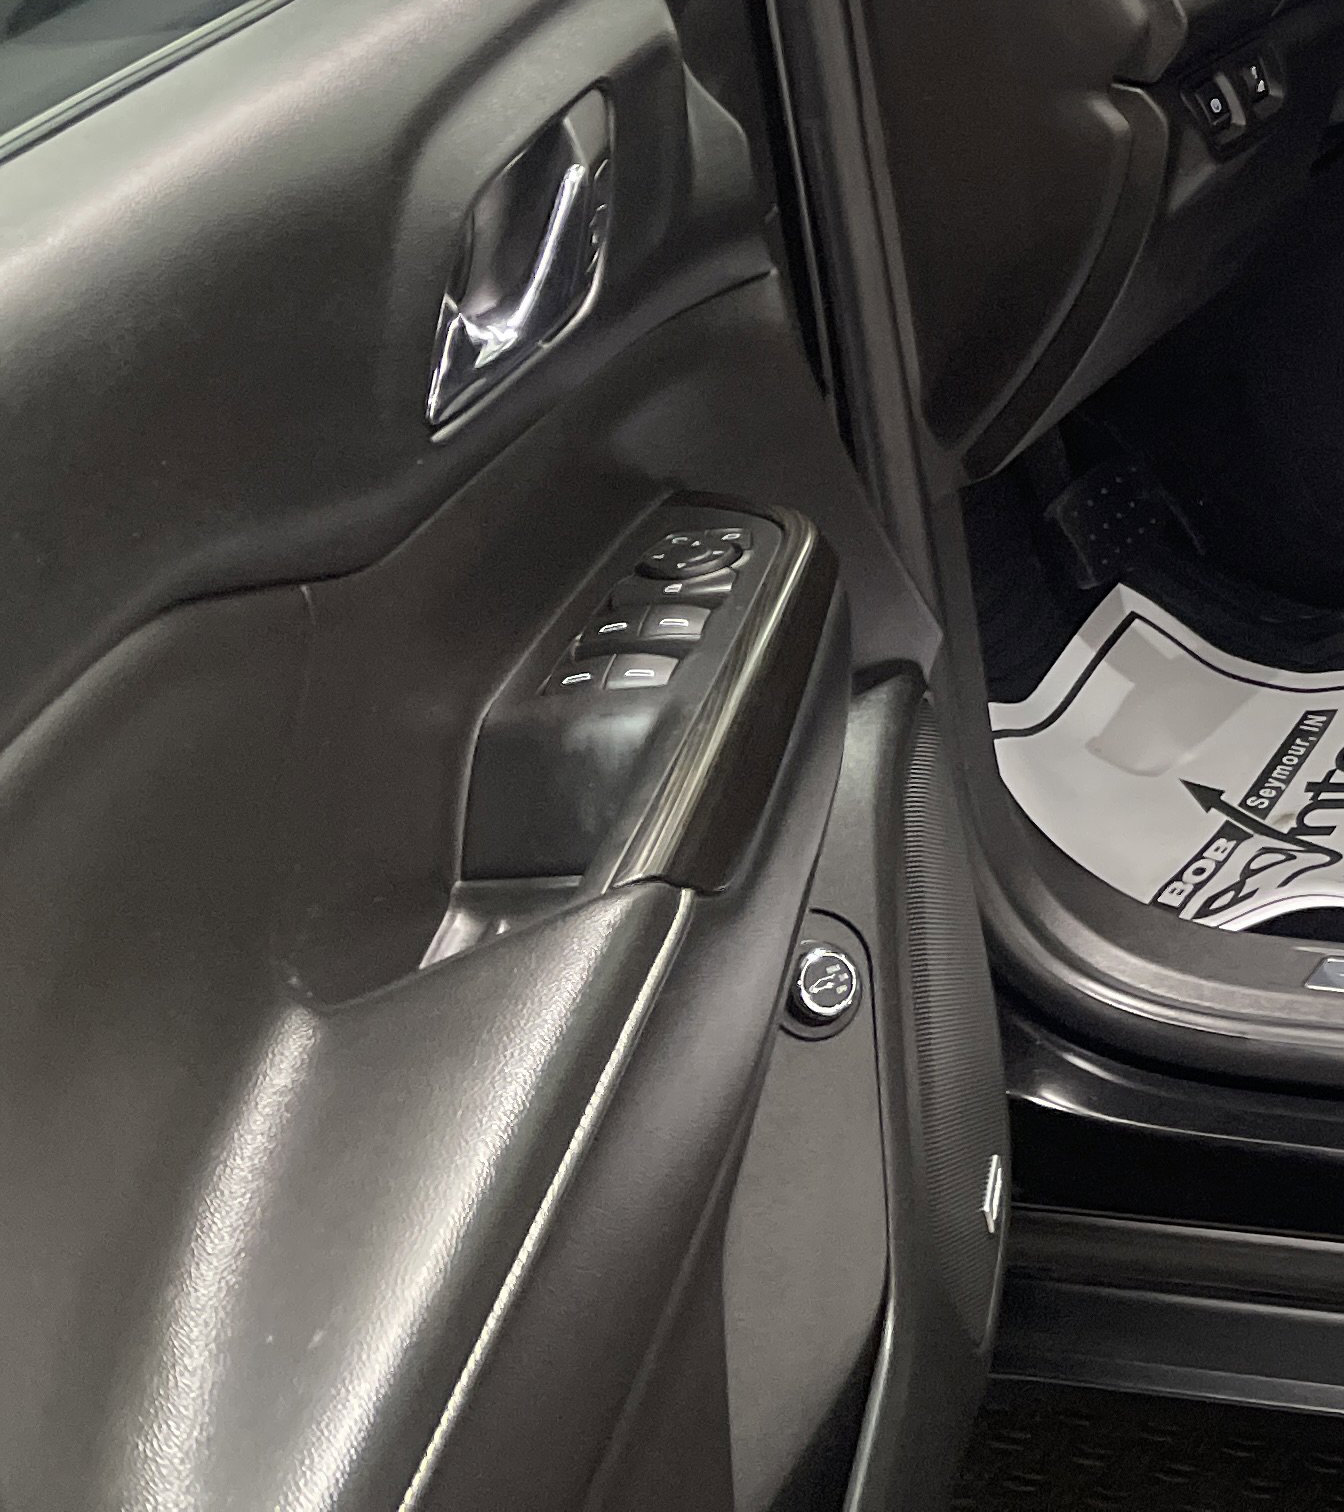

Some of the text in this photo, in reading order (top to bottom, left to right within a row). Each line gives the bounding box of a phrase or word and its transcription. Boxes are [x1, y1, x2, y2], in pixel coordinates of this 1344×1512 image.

[1246, 713, 1328, 809] Seymour, IN
[1157, 837, 1237, 907] BOB
